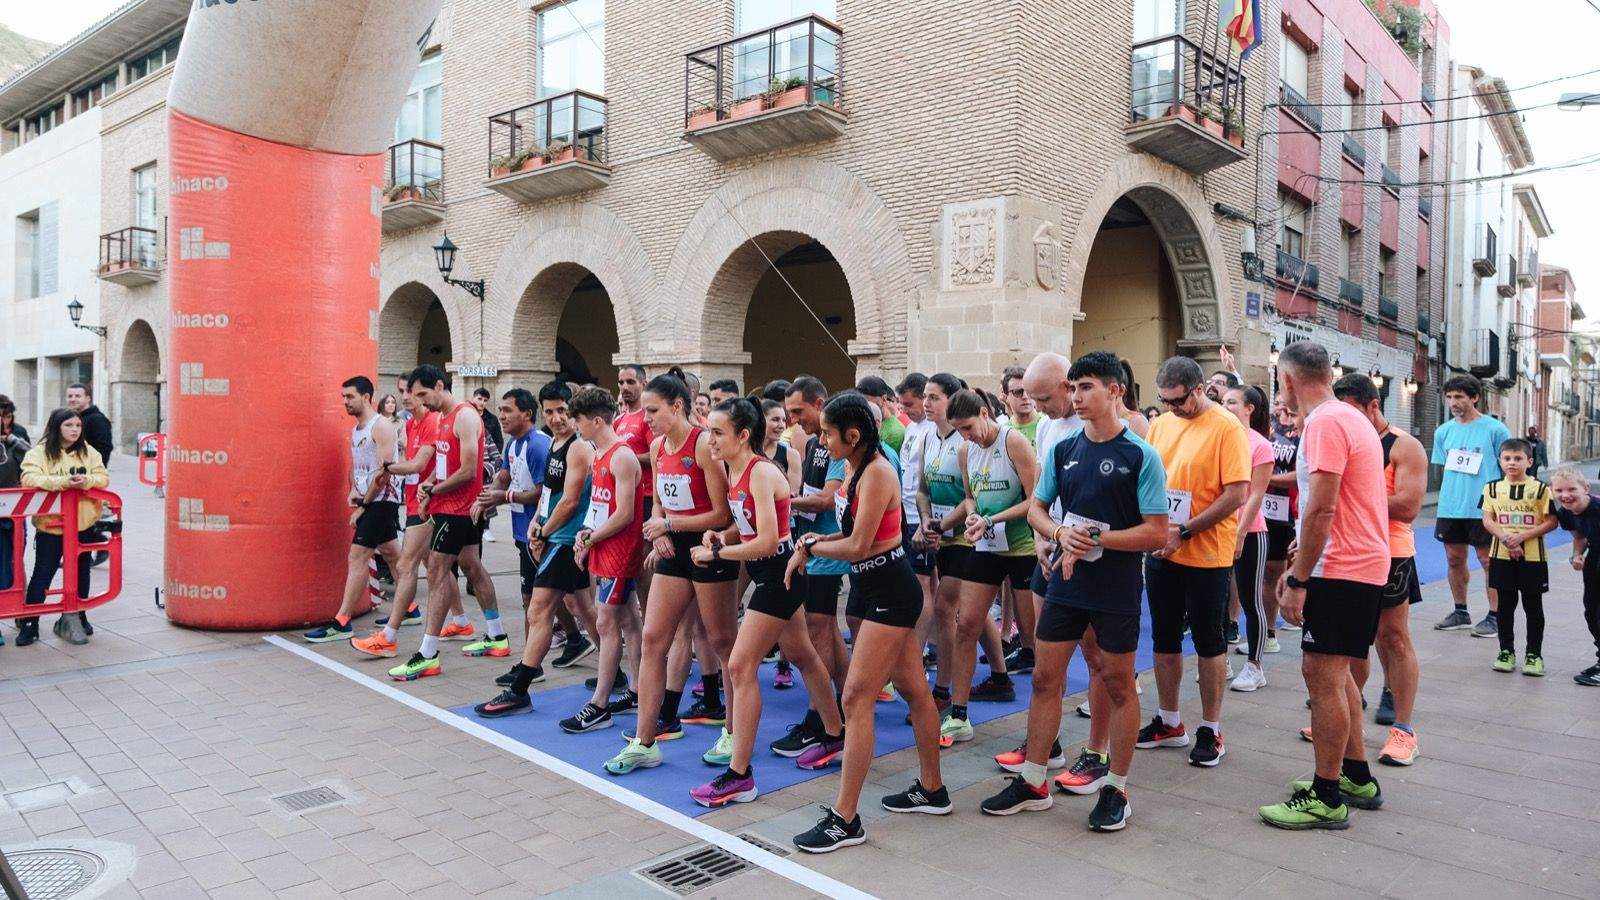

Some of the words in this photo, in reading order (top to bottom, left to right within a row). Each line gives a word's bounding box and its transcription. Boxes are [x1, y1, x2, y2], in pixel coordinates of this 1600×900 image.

[1457, 455, 1470, 466] 91
[664, 483, 678, 497] 62
[1265, 500, 1278, 511] 93
[859, 555, 887, 573] PRO
